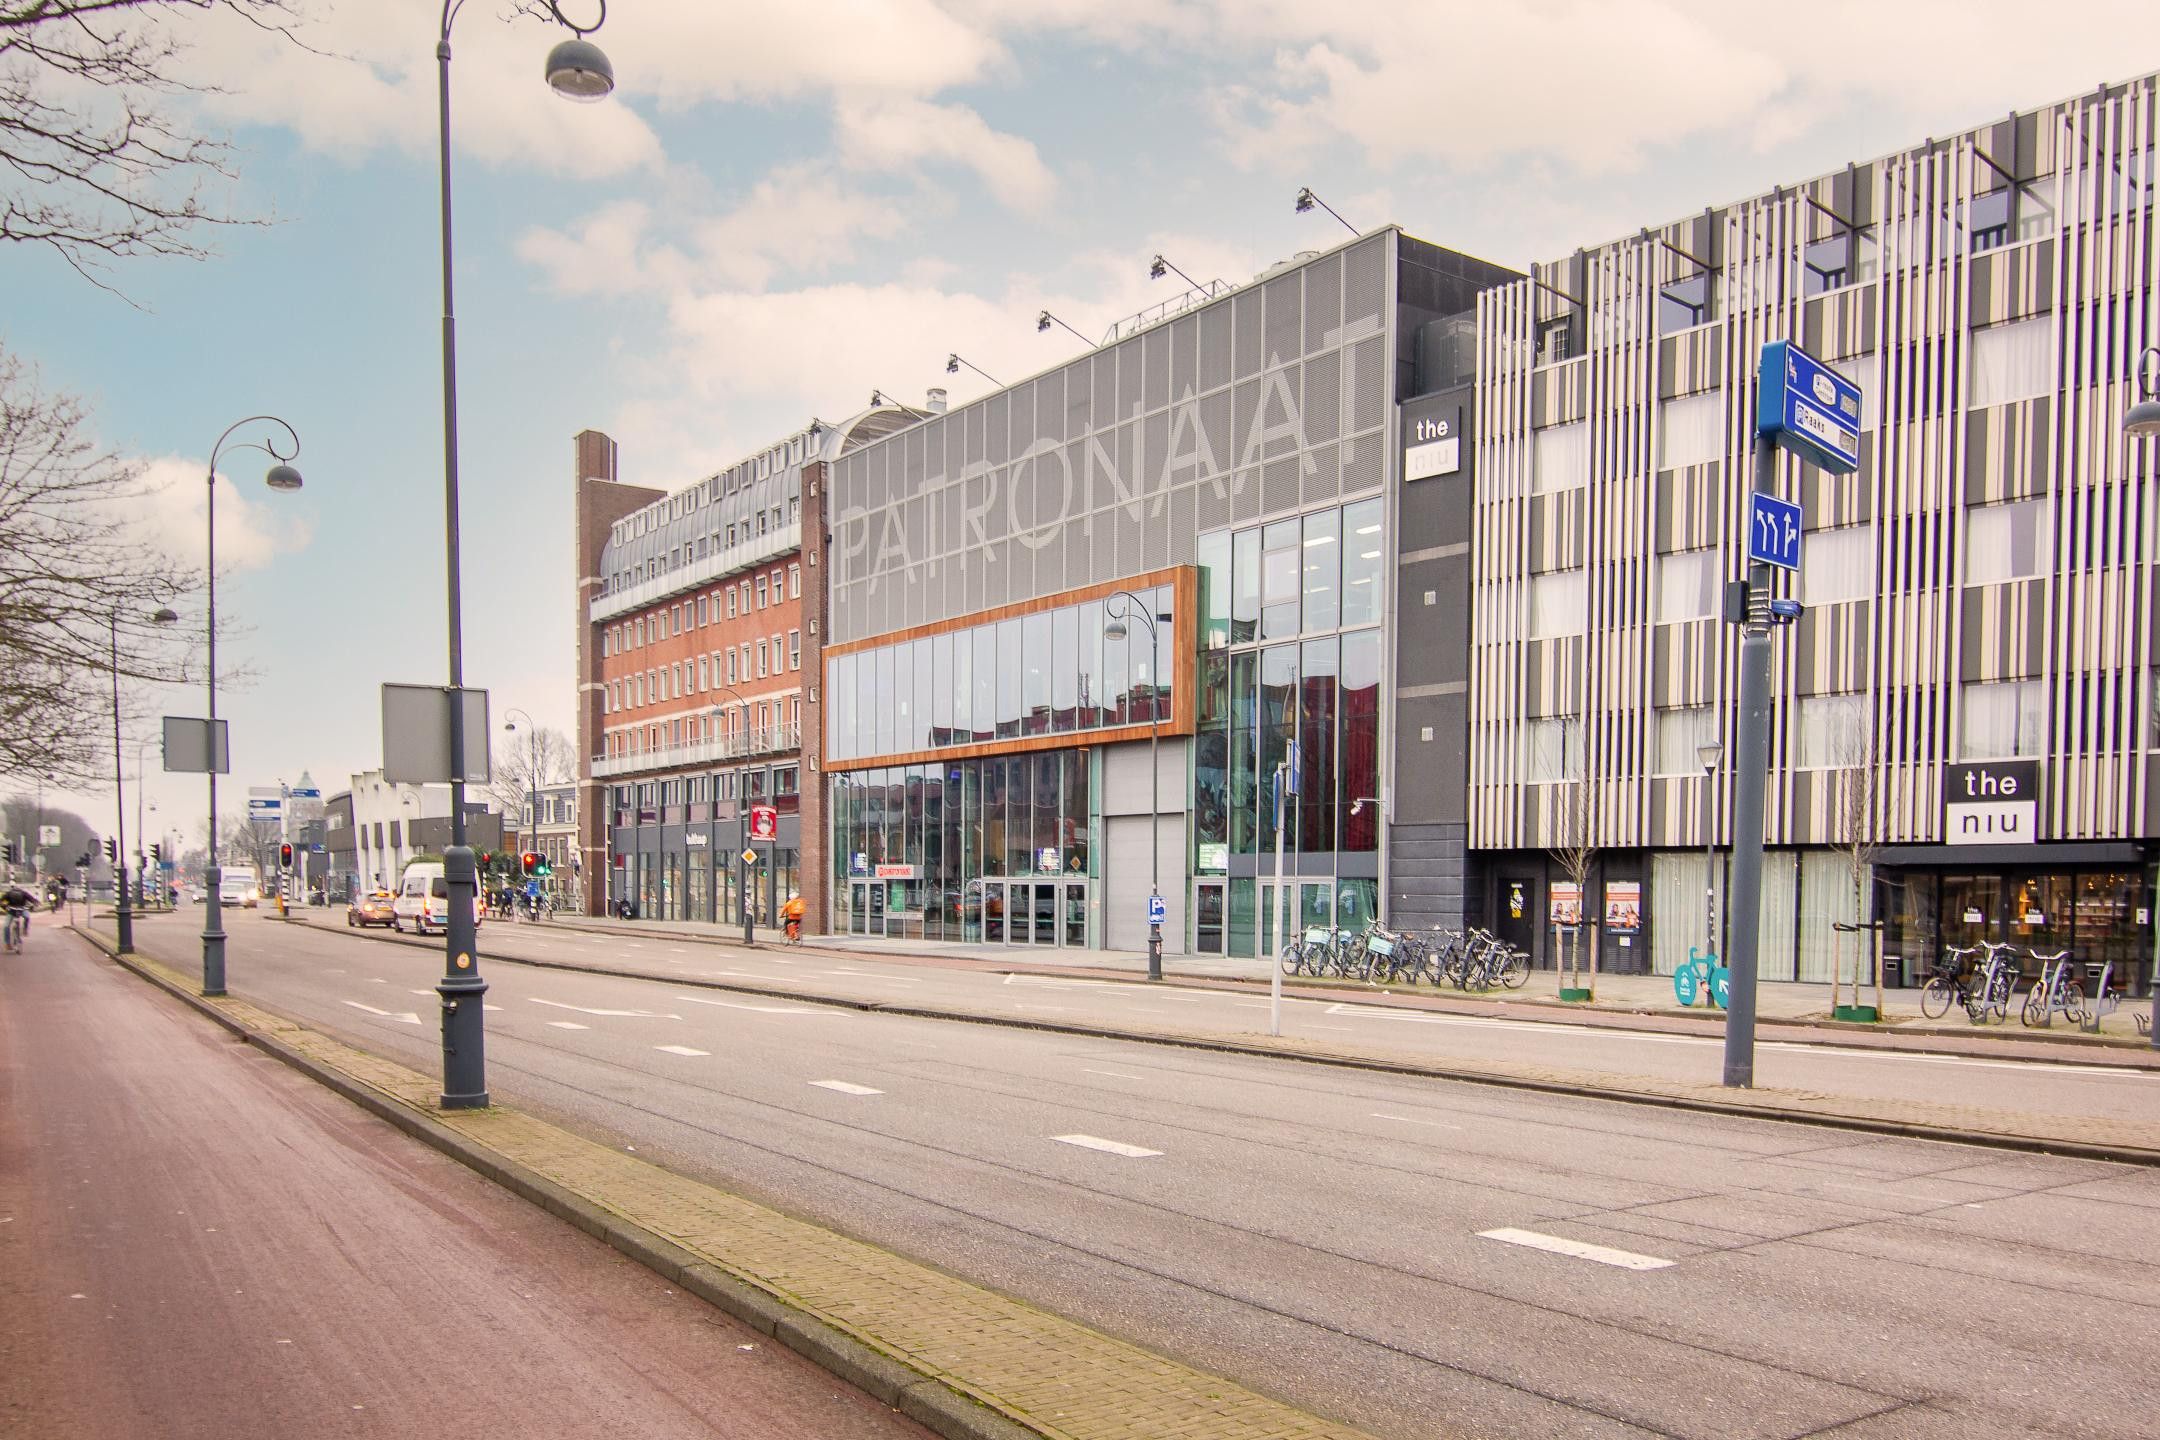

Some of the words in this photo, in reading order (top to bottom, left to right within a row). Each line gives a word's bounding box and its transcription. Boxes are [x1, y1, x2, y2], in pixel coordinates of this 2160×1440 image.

[1416, 418, 1449, 441] the
[1804, 409, 1825, 433] Raaks
[840, 313, 1379, 603] PATRONAAT
[1415, 448, 1448, 471] niu
[1964, 769, 2018, 796] the
[1962, 813, 2018, 834] niu
